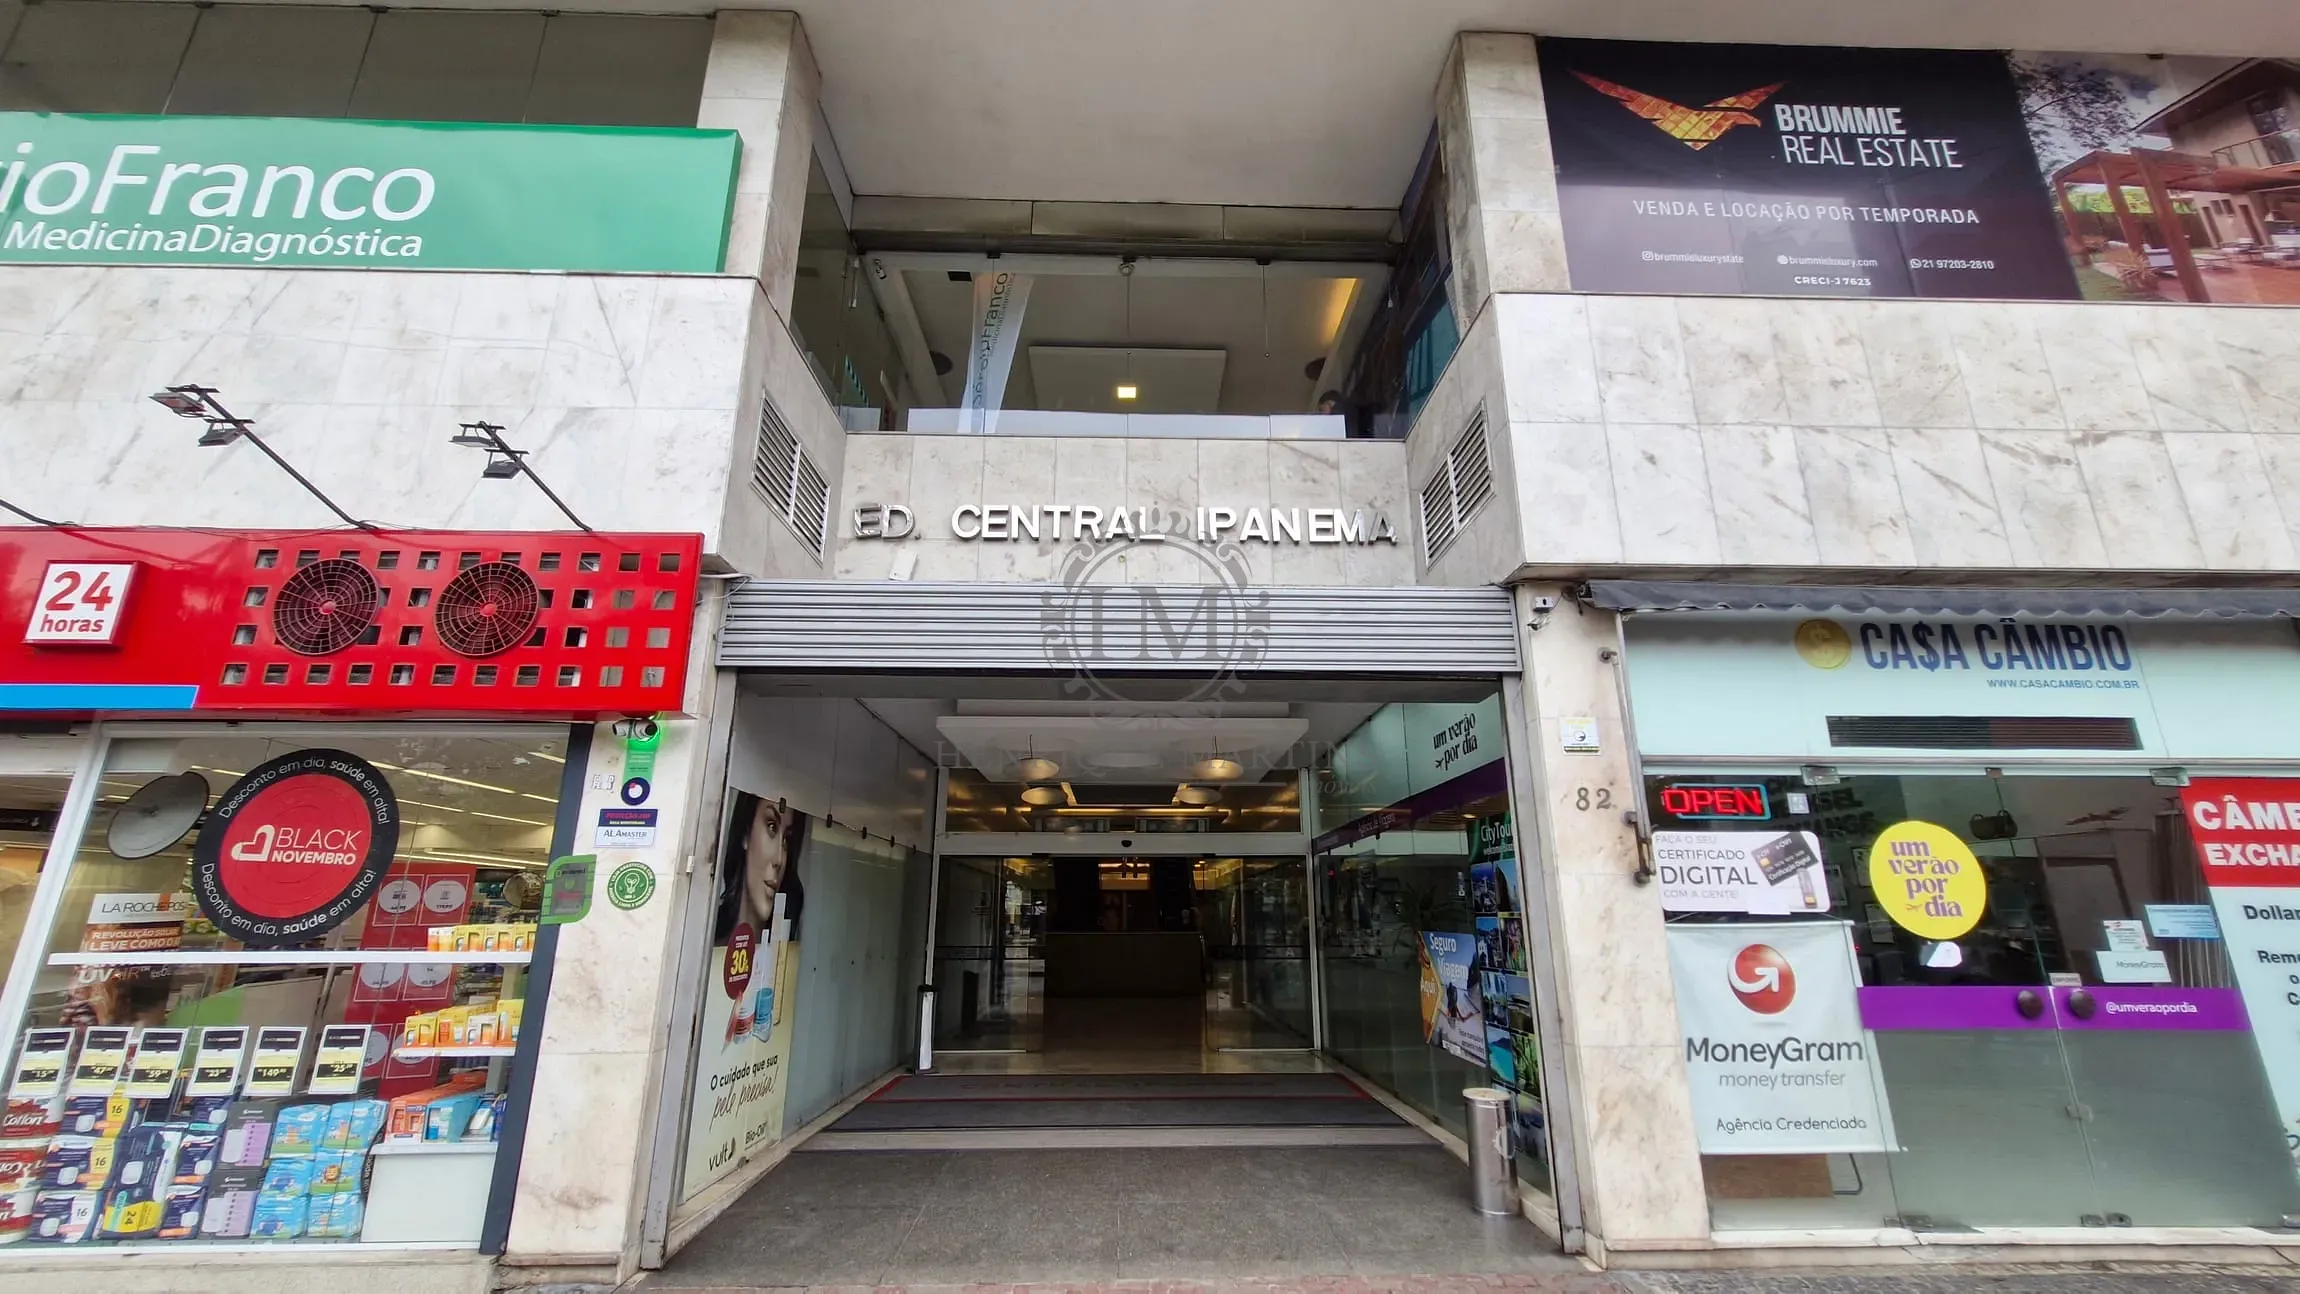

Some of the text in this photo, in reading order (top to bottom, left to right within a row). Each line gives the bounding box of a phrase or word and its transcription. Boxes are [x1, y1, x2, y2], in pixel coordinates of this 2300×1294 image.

[1774, 104, 1906, 135] BRUMMIE
[1782, 135, 1964, 168] REAL ESTATE
[0, 141, 436, 222] ioFranco
[1633, 200, 1980, 224] VENDA E LOCAÇÃO POR TEMPORADA
[4, 220, 423, 262] MedicinaDiagnóstica
[1922, 259, 1934, 269] 21
[854, 503, 1399, 545] ED. CENTRAL IPANEMA
[45, 571, 114, 612] 24
[40, 614, 105, 633] horas
[1859, 618, 2133, 672] CA$A CÂMBIO
[1987, 679, 2140, 690] WWW.CASACAMBIO.COM.BR
[1433, 713, 1476, 750] um verão
[1444, 733, 1478, 771] por dia
[219, 770, 276, 819] Desconto
[279, 760, 301, 774] em
[330, 760, 366, 781] saúde
[364, 779, 380, 799] em
[374, 796, 391, 825] alta!
[1576, 787, 1612, 811] 82
[1663, 789, 1763, 816] OPEN
[276, 827, 363, 851] BLACK
[1480, 822, 1512, 843] CityTou
[1655, 835, 1718, 845] FAÇA O SEU
[272, 851, 356, 866] NOVEMBRO
[1658, 849, 1745, 860] CERTIFICADO
[1890, 841, 1930, 857] um
[1660, 866, 1758, 885] DIGITAL
[1888, 856, 1960, 875] verão
[1664, 890, 1688, 899] COM
[1691, 890, 1701, 898] A
[1905, 878, 1948, 899] por
[102, 903, 121, 914] LA
[201, 863, 232, 918] Desconto
[231, 915, 252, 930] em
[254, 923, 280, 937] dia,
[283, 912, 327, 935] saúde
[329, 898, 351, 917] em
[351, 869, 377, 899] alta!
[1925, 895, 1962, 917] dia
[89, 940, 127, 952] LEVE
[130, 939, 167, 949] COMO
[1430, 933, 1457, 955] Seguro
[1437, 957, 1469, 980] Viagem
[2106, 1001, 2198, 1016] @umveraopordia
[1686, 1037, 1863, 1069] MoneyGram
[710, 1055, 779, 1091] O cuidado que sua
[1719, 1070, 1846, 1091] money transfer
[111, 1105, 122, 1114] 16
[1716, 1116, 1867, 1135] Agência Credenciada
[95, 1157, 106, 1166] 16
[709, 1141, 728, 1171] vult
[76, 1208, 88, 1217] 16
[125, 1211, 137, 1225] 24
